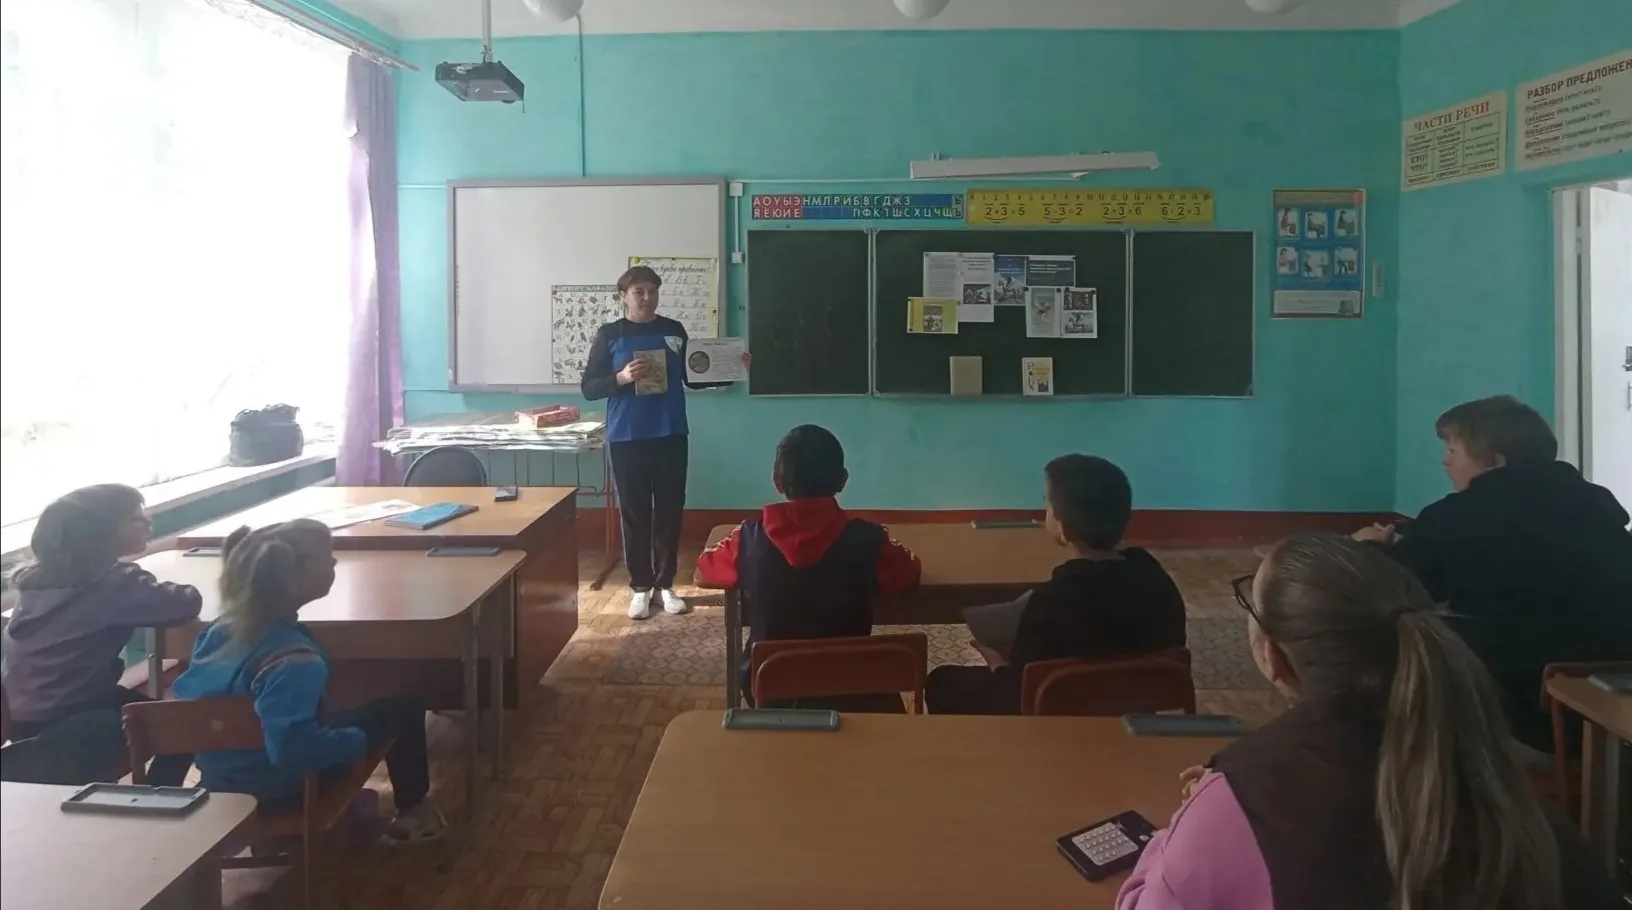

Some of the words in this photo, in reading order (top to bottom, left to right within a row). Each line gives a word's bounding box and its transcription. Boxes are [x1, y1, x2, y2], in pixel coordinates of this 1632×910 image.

[1527, 81, 1564, 99] РАЗБОР
[1414, 113, 1452, 131] ЧАСТИ
[1455, 101, 1490, 121] РЕЧИ
